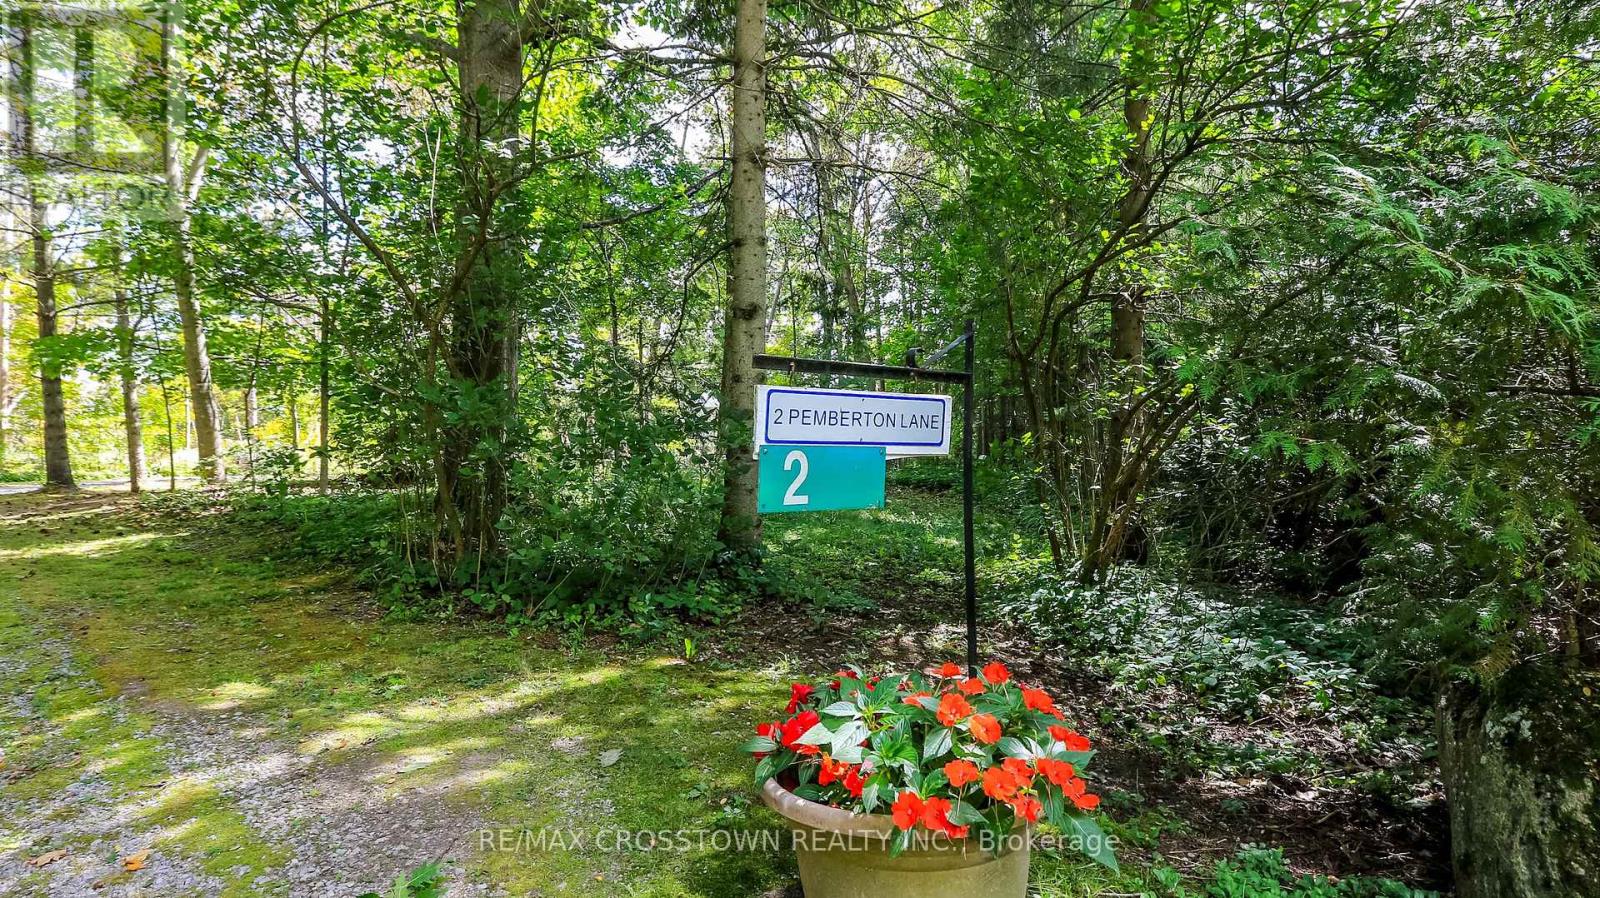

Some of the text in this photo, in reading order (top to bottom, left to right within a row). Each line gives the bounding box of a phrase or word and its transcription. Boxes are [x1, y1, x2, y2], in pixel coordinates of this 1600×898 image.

[774, 408, 940, 429] 2 PEMBERTON LANE
[783, 450, 809, 506] 2
